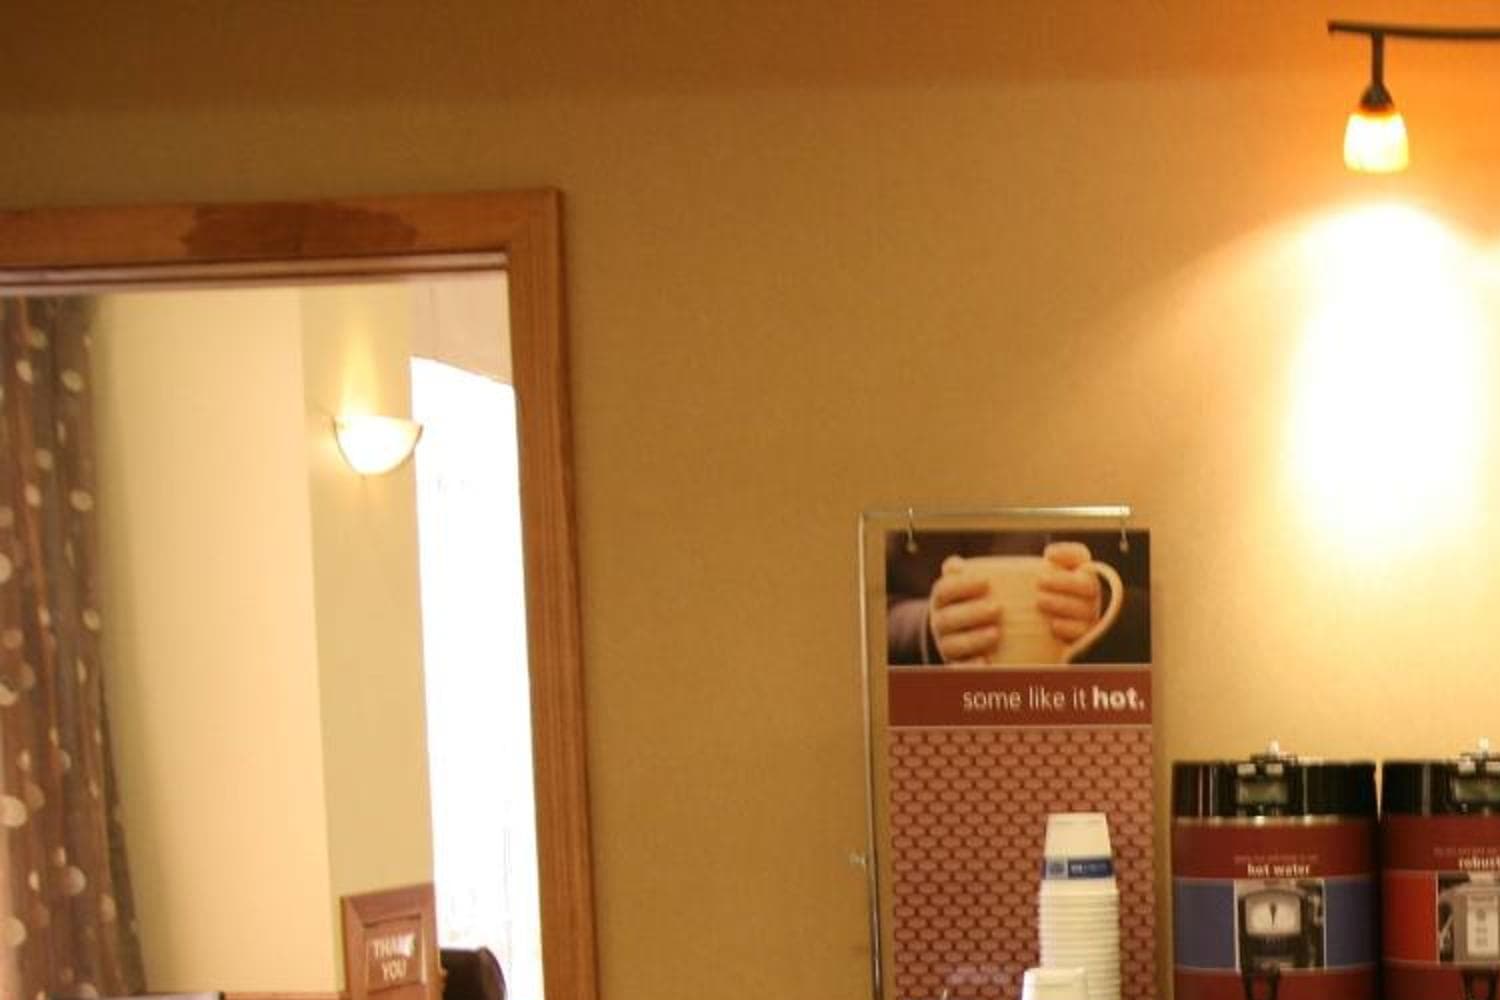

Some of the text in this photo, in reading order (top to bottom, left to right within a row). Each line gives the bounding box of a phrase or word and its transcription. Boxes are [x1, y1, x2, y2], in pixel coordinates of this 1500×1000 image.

[963, 685, 1146, 710] some like it hot.
[1247, 863, 1311, 877] hot water
[1459, 856, 1500, 872] robust
[381, 958, 407, 980] YOU
